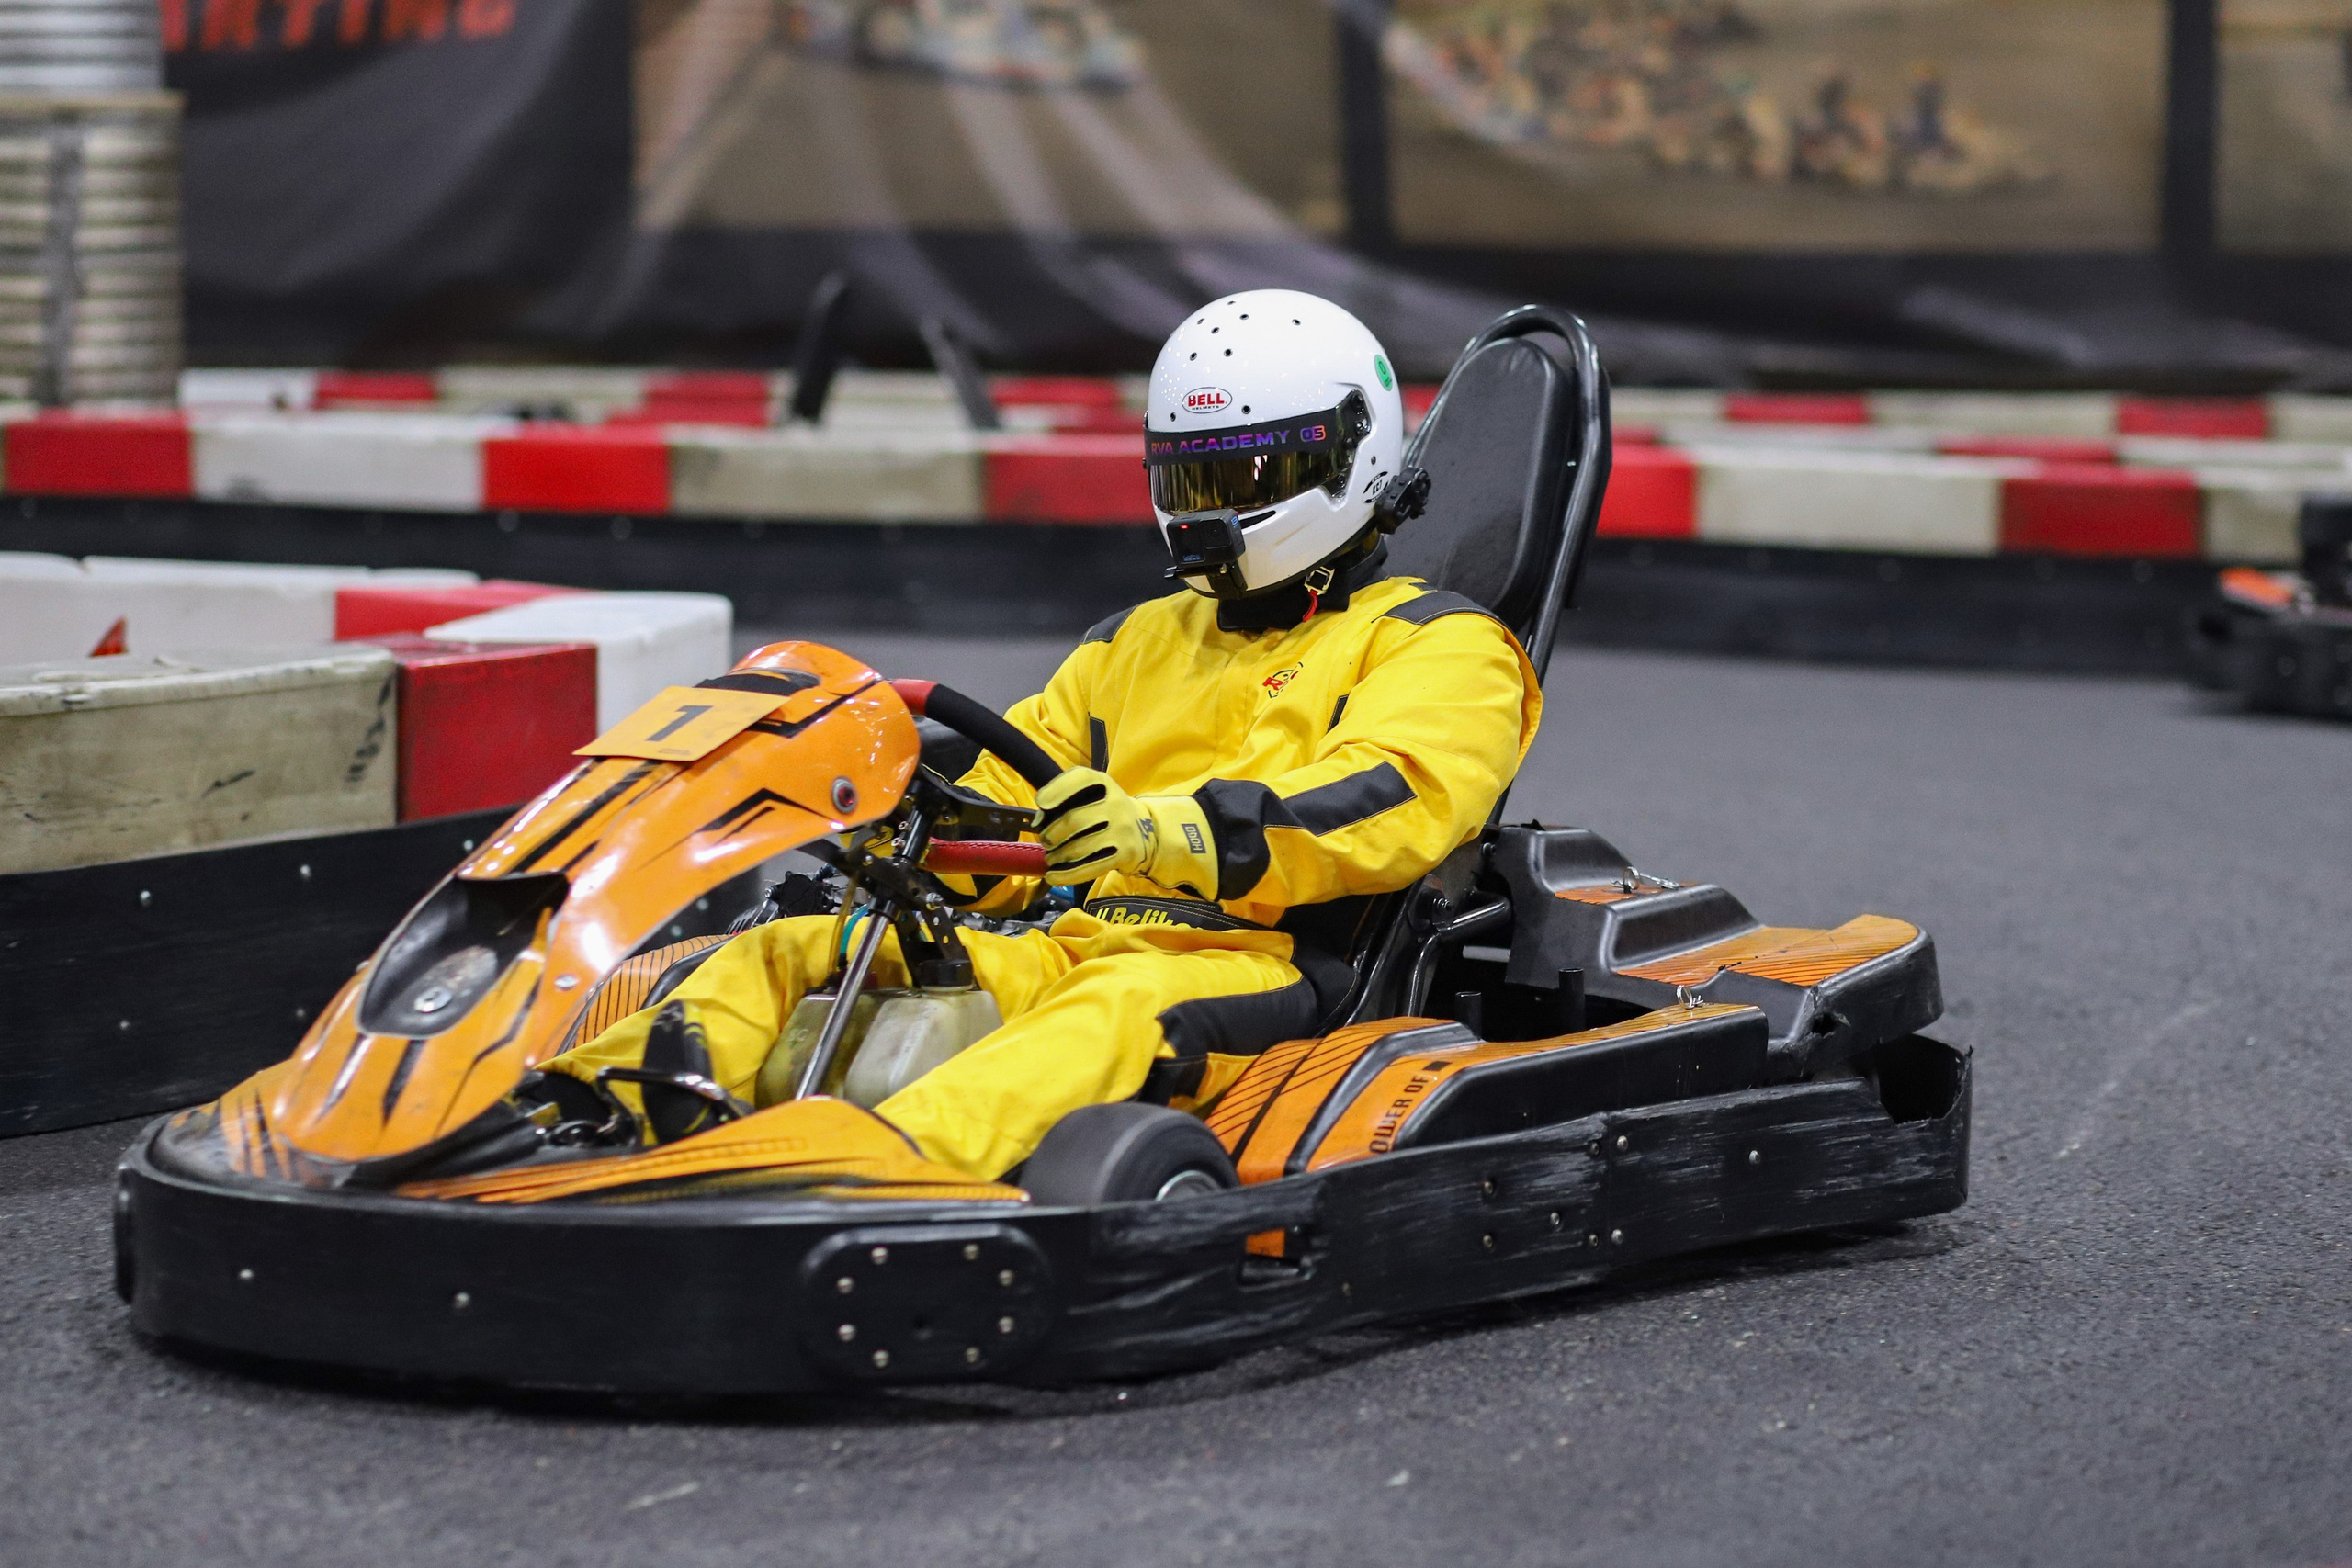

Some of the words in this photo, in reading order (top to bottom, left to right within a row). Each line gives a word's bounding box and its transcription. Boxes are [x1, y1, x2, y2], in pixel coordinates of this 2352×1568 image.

[1188, 393, 1225, 407] BELL
[1178, 430, 1290, 453] ACADEMY
[646, 705, 713, 741] 1
[1369, 1098, 1412, 1154] OWER
[1403, 1076, 1429, 1094] OF
